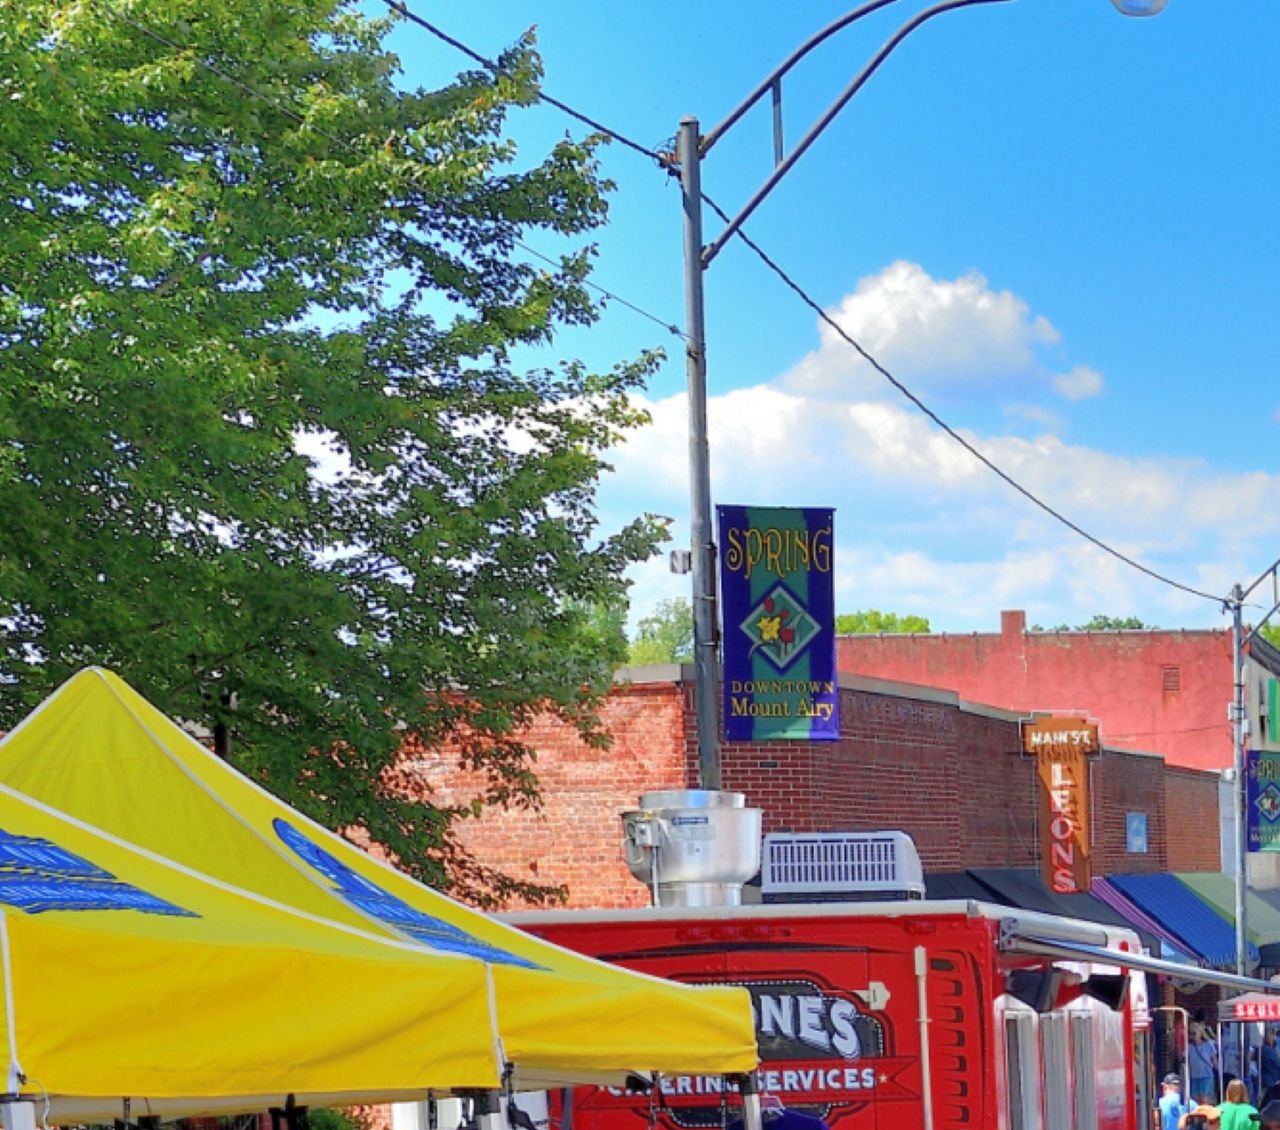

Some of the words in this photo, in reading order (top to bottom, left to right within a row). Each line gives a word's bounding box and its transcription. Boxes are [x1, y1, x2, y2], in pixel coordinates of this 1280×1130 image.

[726, 527, 832, 580] SPRING
[731, 680, 834, 694] DOWNTOWN
[730, 697, 791, 717] Mount
[796, 698, 835, 721] Airy
[1031, 731, 1068, 745] MAIN
[1051, 762, 1079, 894] LEONS
[752, 995, 862, 1062] NES
[756, 1068, 876, 1091] SERVICES
